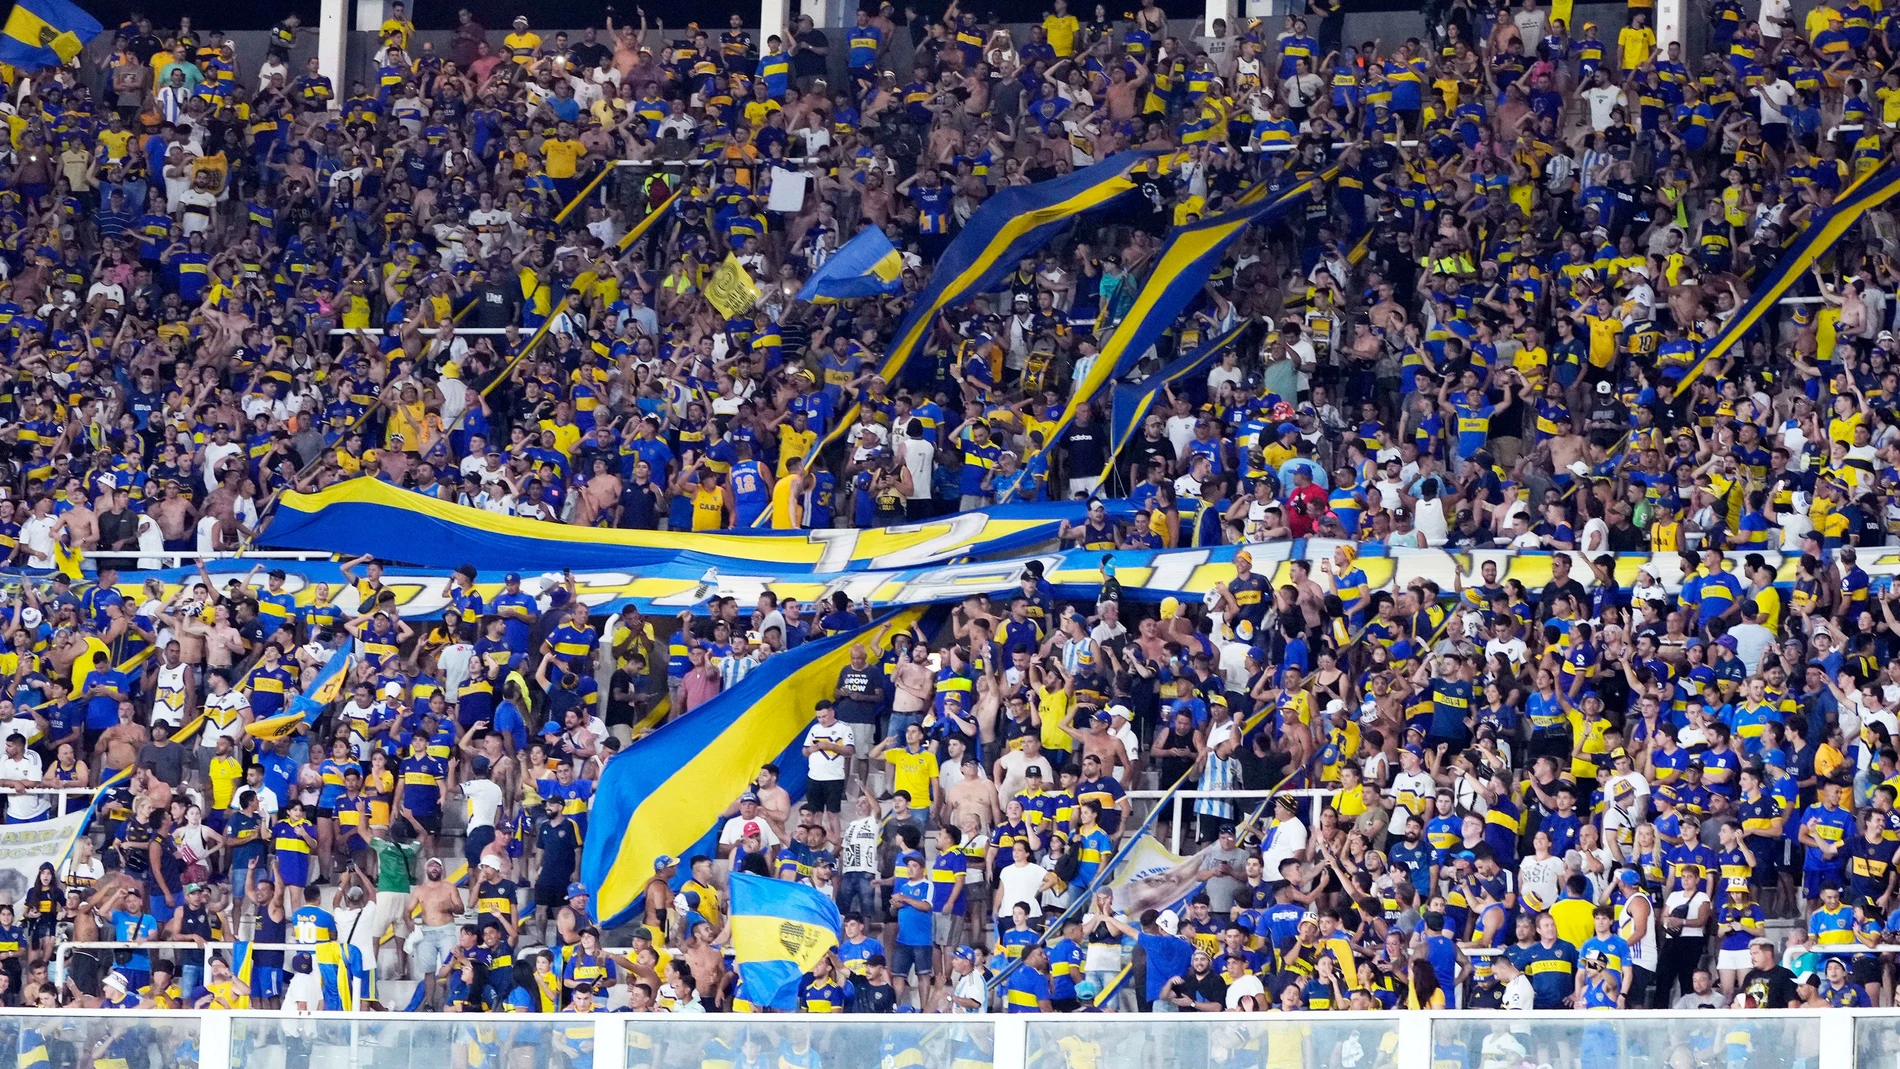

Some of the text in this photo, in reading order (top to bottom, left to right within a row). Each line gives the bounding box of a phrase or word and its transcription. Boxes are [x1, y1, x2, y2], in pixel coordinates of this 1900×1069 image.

[1639, 335, 1652, 352] 10
[1070, 434, 1092, 443] adidas
[919, 453, 927, 473] 7
[734, 475, 756, 495] 12
[808, 513, 990, 574] 12
[160, 689, 171, 699] 12
[1441, 696, 1461, 706] BBVA
[1272, 911, 1298, 922] PEPSI
[298, 922, 318, 944] 10
